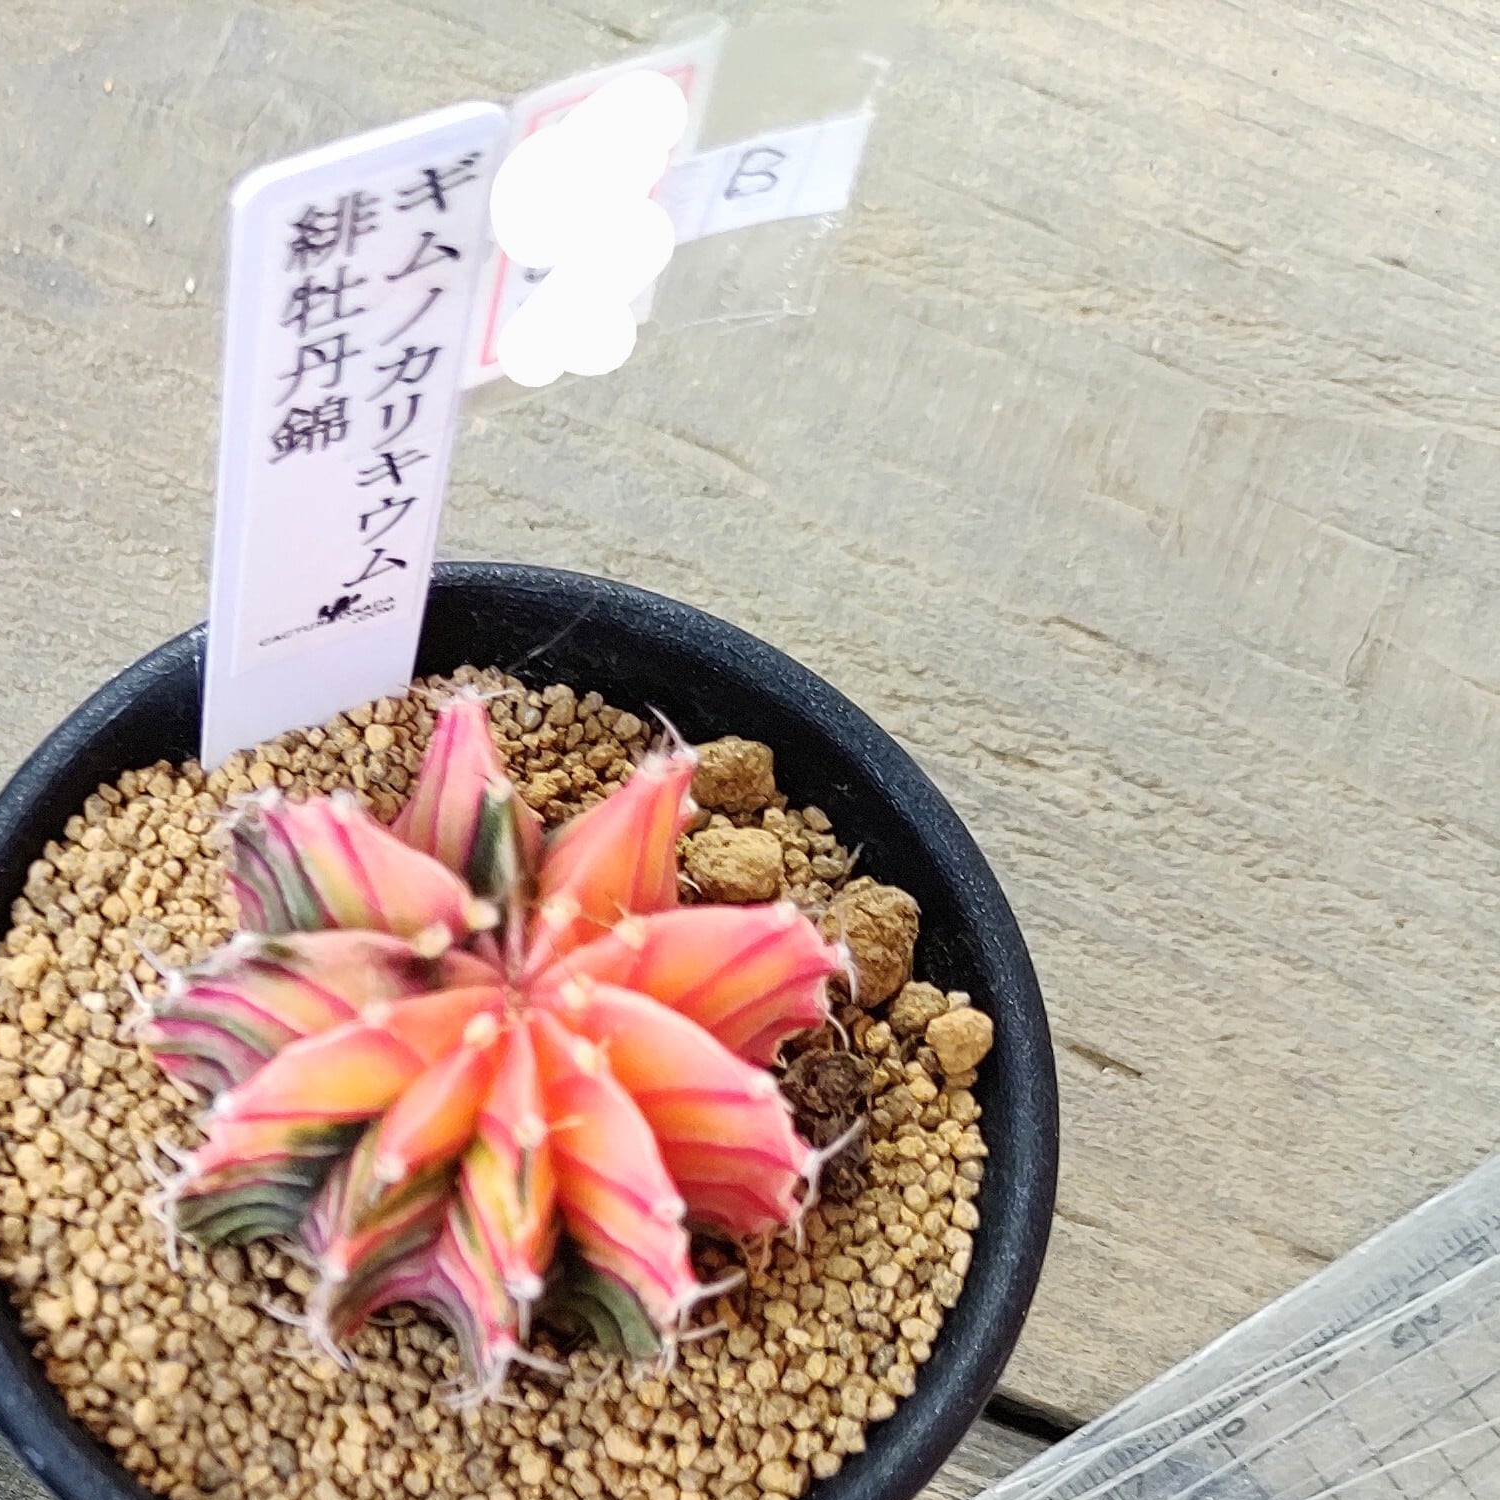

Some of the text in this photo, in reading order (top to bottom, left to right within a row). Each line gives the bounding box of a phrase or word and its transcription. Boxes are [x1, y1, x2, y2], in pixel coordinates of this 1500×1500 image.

[268, 191, 381, 465] 緋牡丹錦
[342, 151, 483, 588] ギムノカリキウム
